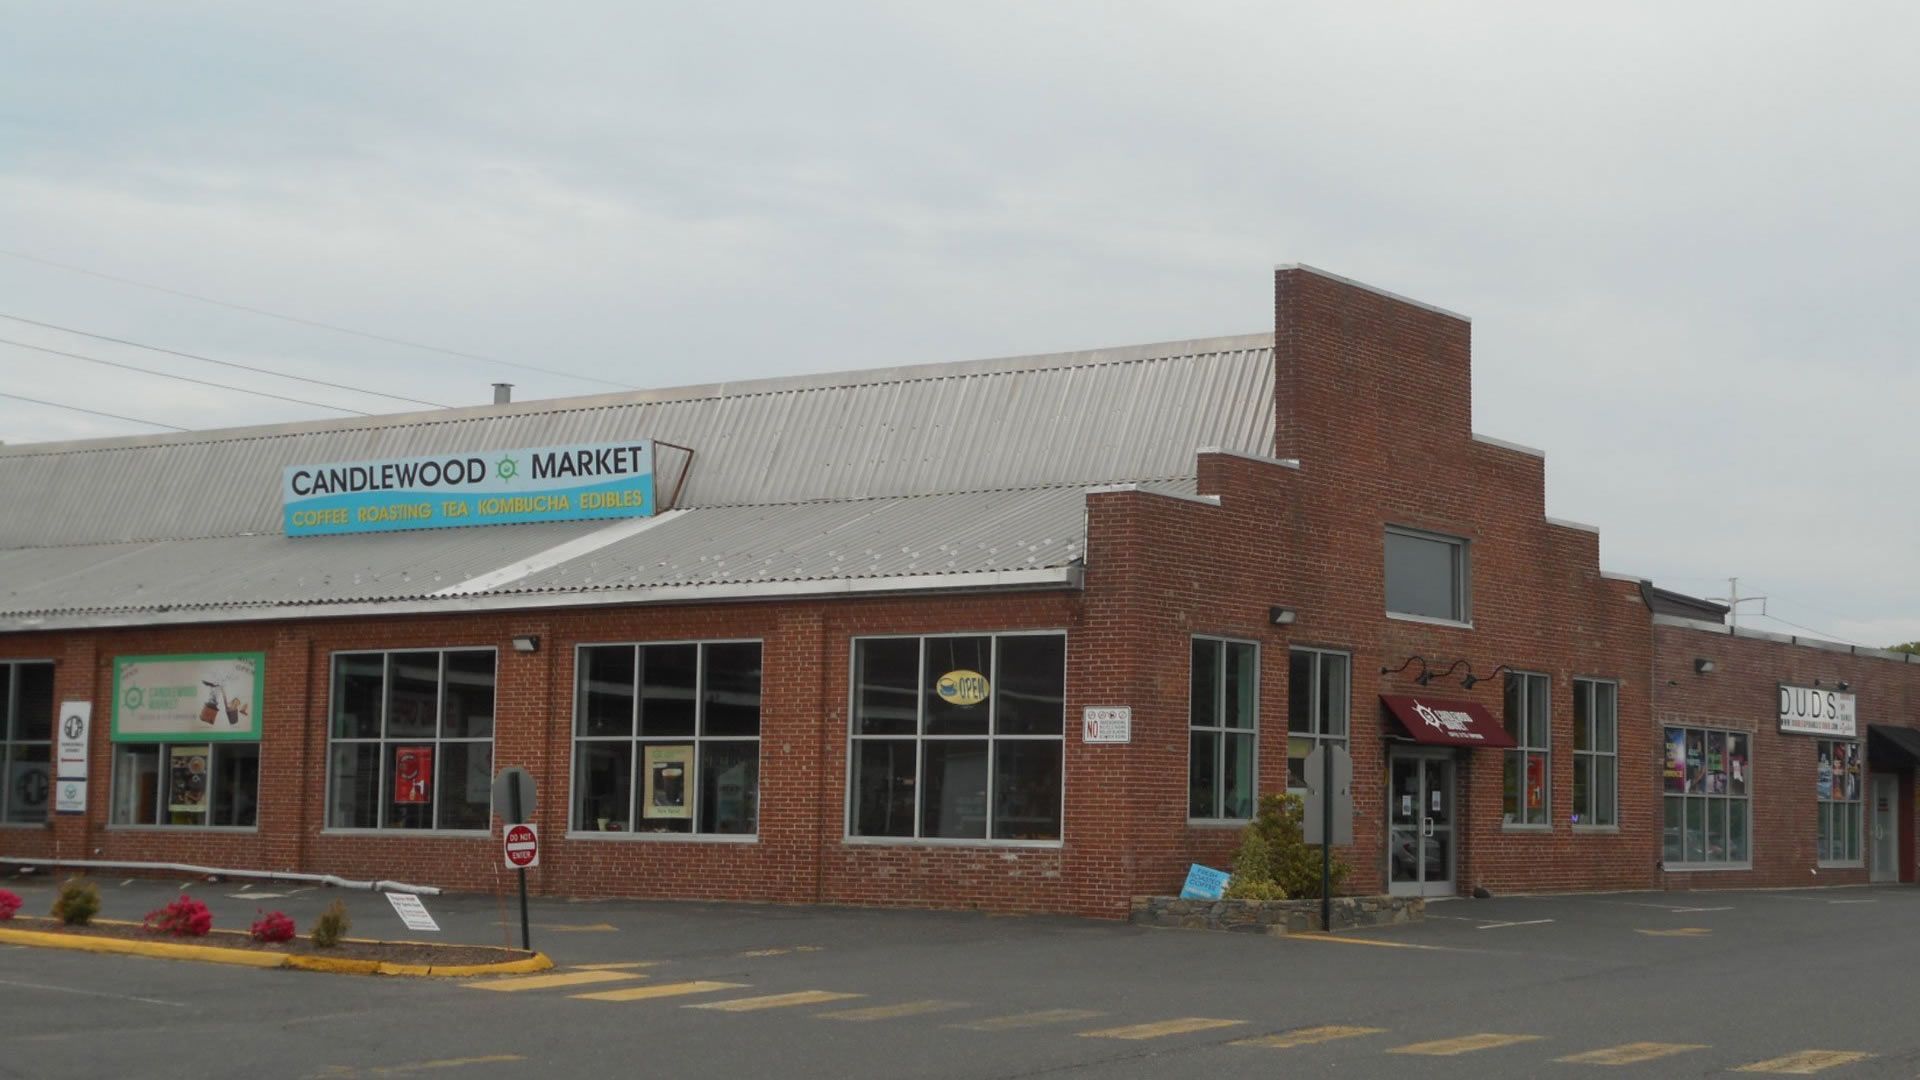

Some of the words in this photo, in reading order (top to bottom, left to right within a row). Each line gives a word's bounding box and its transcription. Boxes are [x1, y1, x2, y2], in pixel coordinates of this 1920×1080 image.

[291, 457, 486, 496] CANDLEWOOD
[531, 445, 642, 480] MARKET
[292, 507, 349, 527] COFFEE
[357, 502, 432, 522] ROASTING
[442, 502, 468, 518] TEA
[478, 494, 569, 515] KOMBUCHA
[580, 489, 643, 508] EDIBLES
[959, 677, 984, 699] OPEN
[1087, 720, 1099, 738] NO
[520, 833, 531, 841] NOT
[512, 851, 531, 859] ENTER
